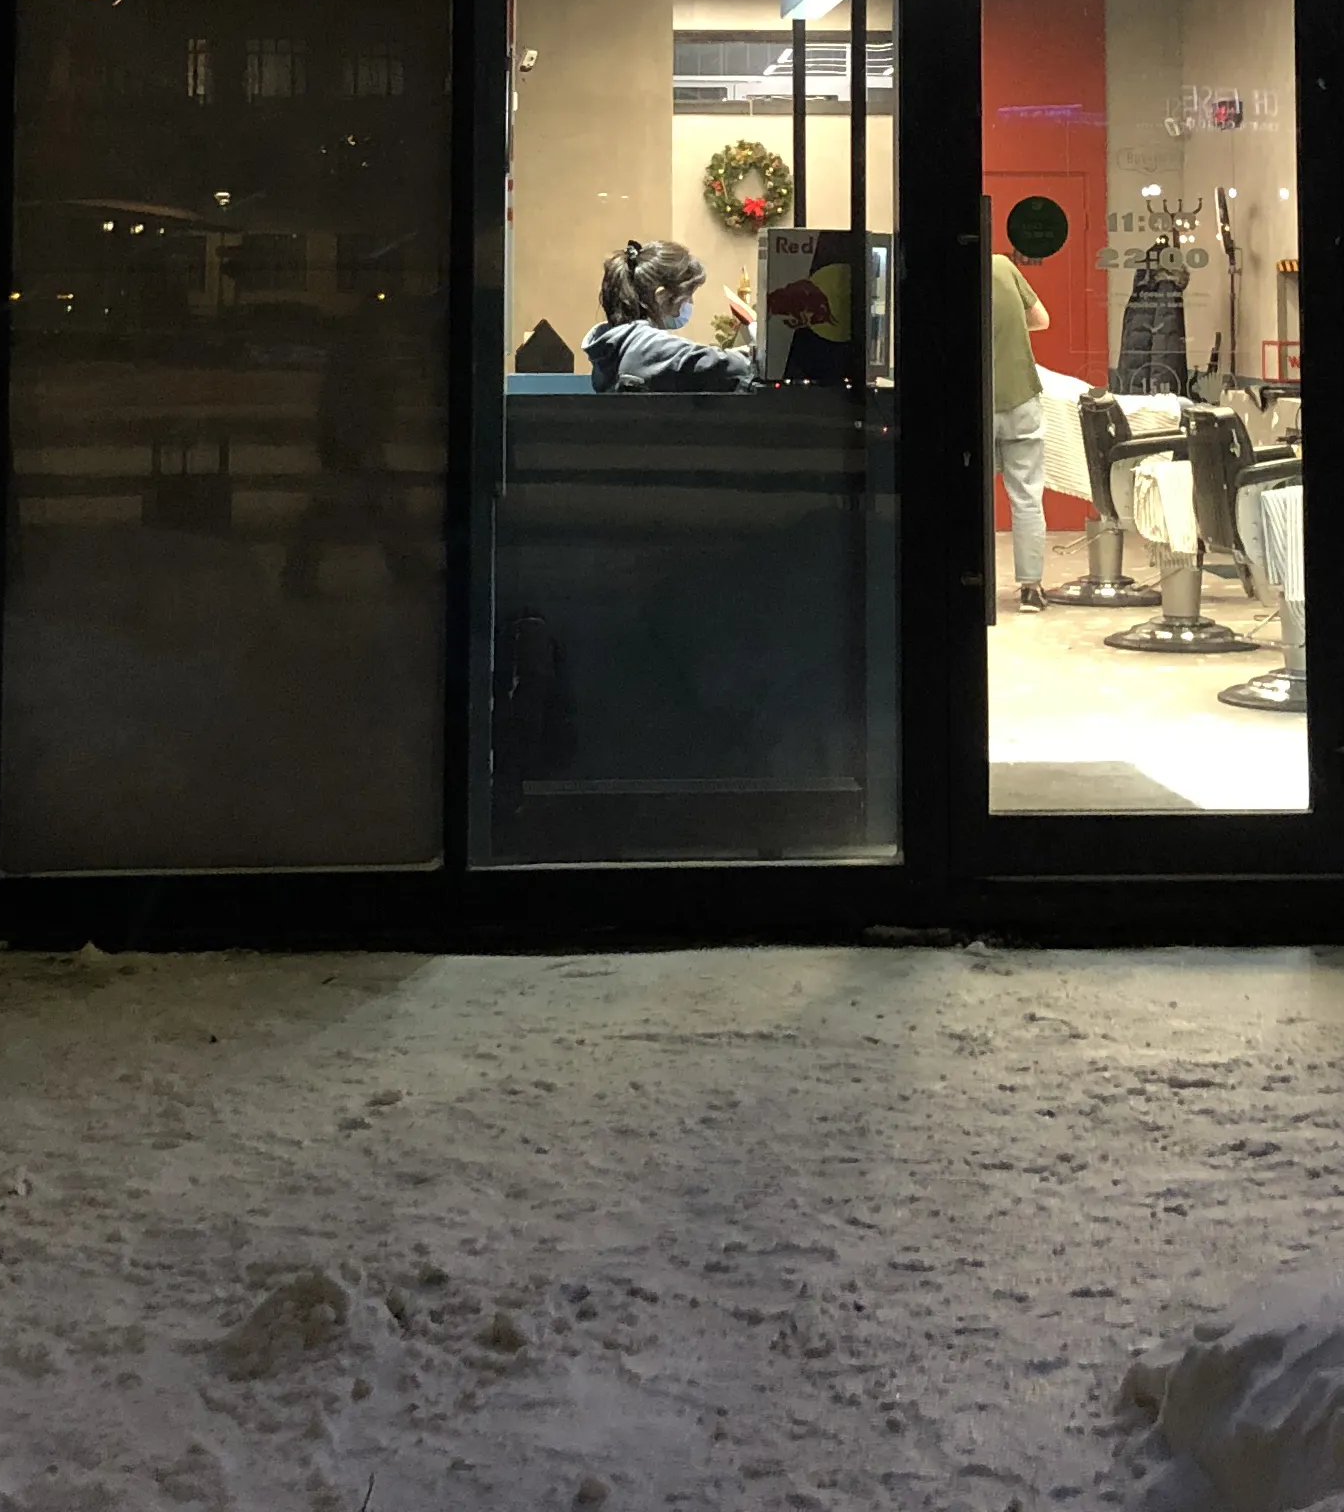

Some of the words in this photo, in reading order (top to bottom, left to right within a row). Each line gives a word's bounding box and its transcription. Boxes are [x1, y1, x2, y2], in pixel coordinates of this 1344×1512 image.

[1107, 210, 1197, 233] 11:00
[774, 235, 814, 254] Red
[1094, 246, 1210, 270] 22:00
